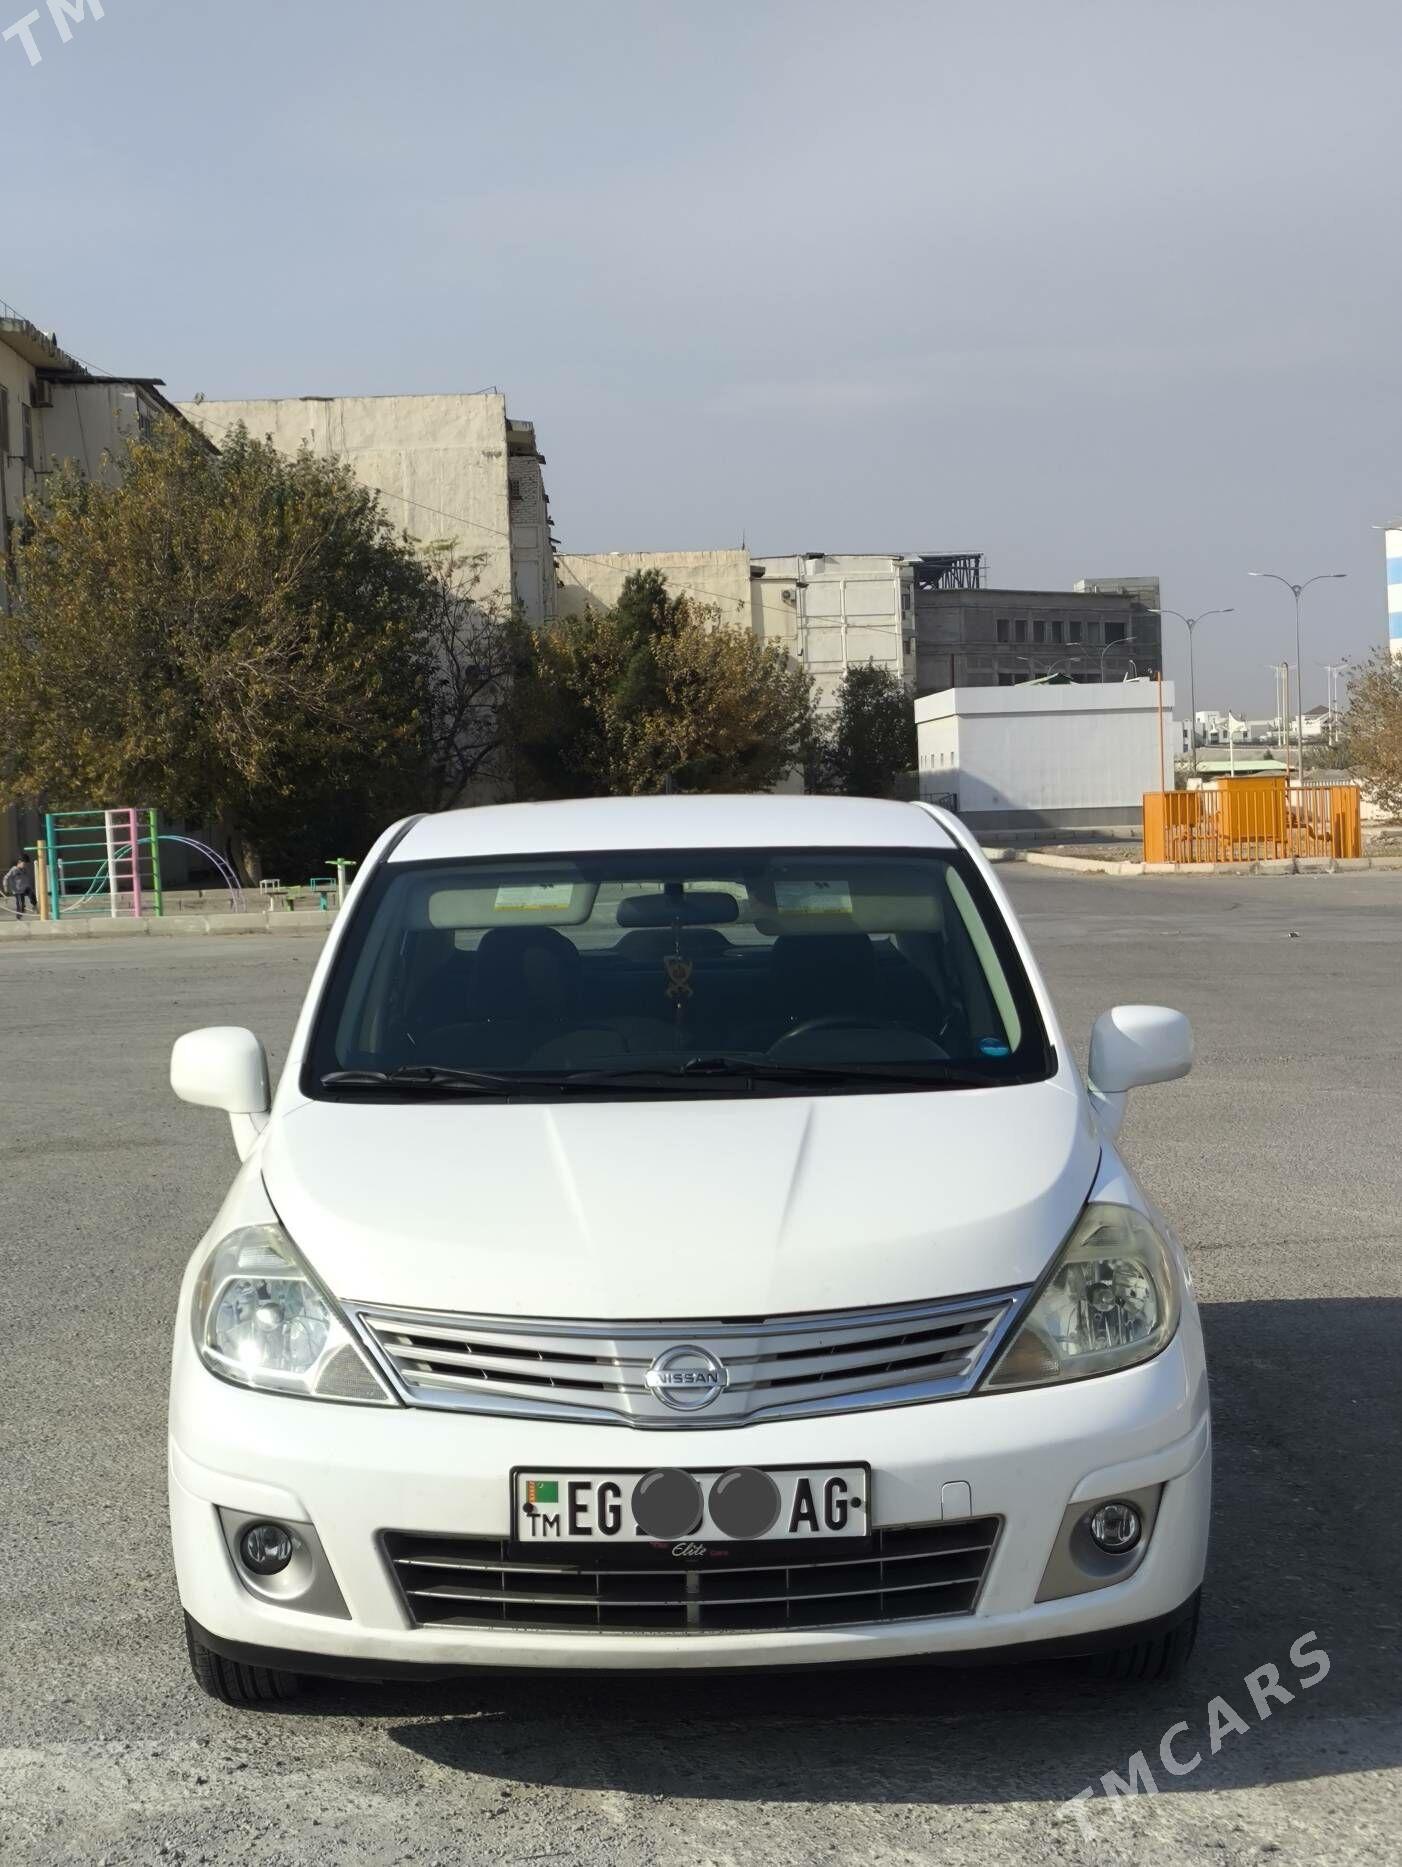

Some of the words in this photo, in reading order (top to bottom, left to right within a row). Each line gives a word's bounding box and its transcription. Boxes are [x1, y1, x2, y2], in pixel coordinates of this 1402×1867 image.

[657, 1372, 718, 1384] NISSAN
[567, 1481, 622, 1536] EG
[789, 1477, 848, 1534] AG
[526, 1512, 560, 1537] TM
